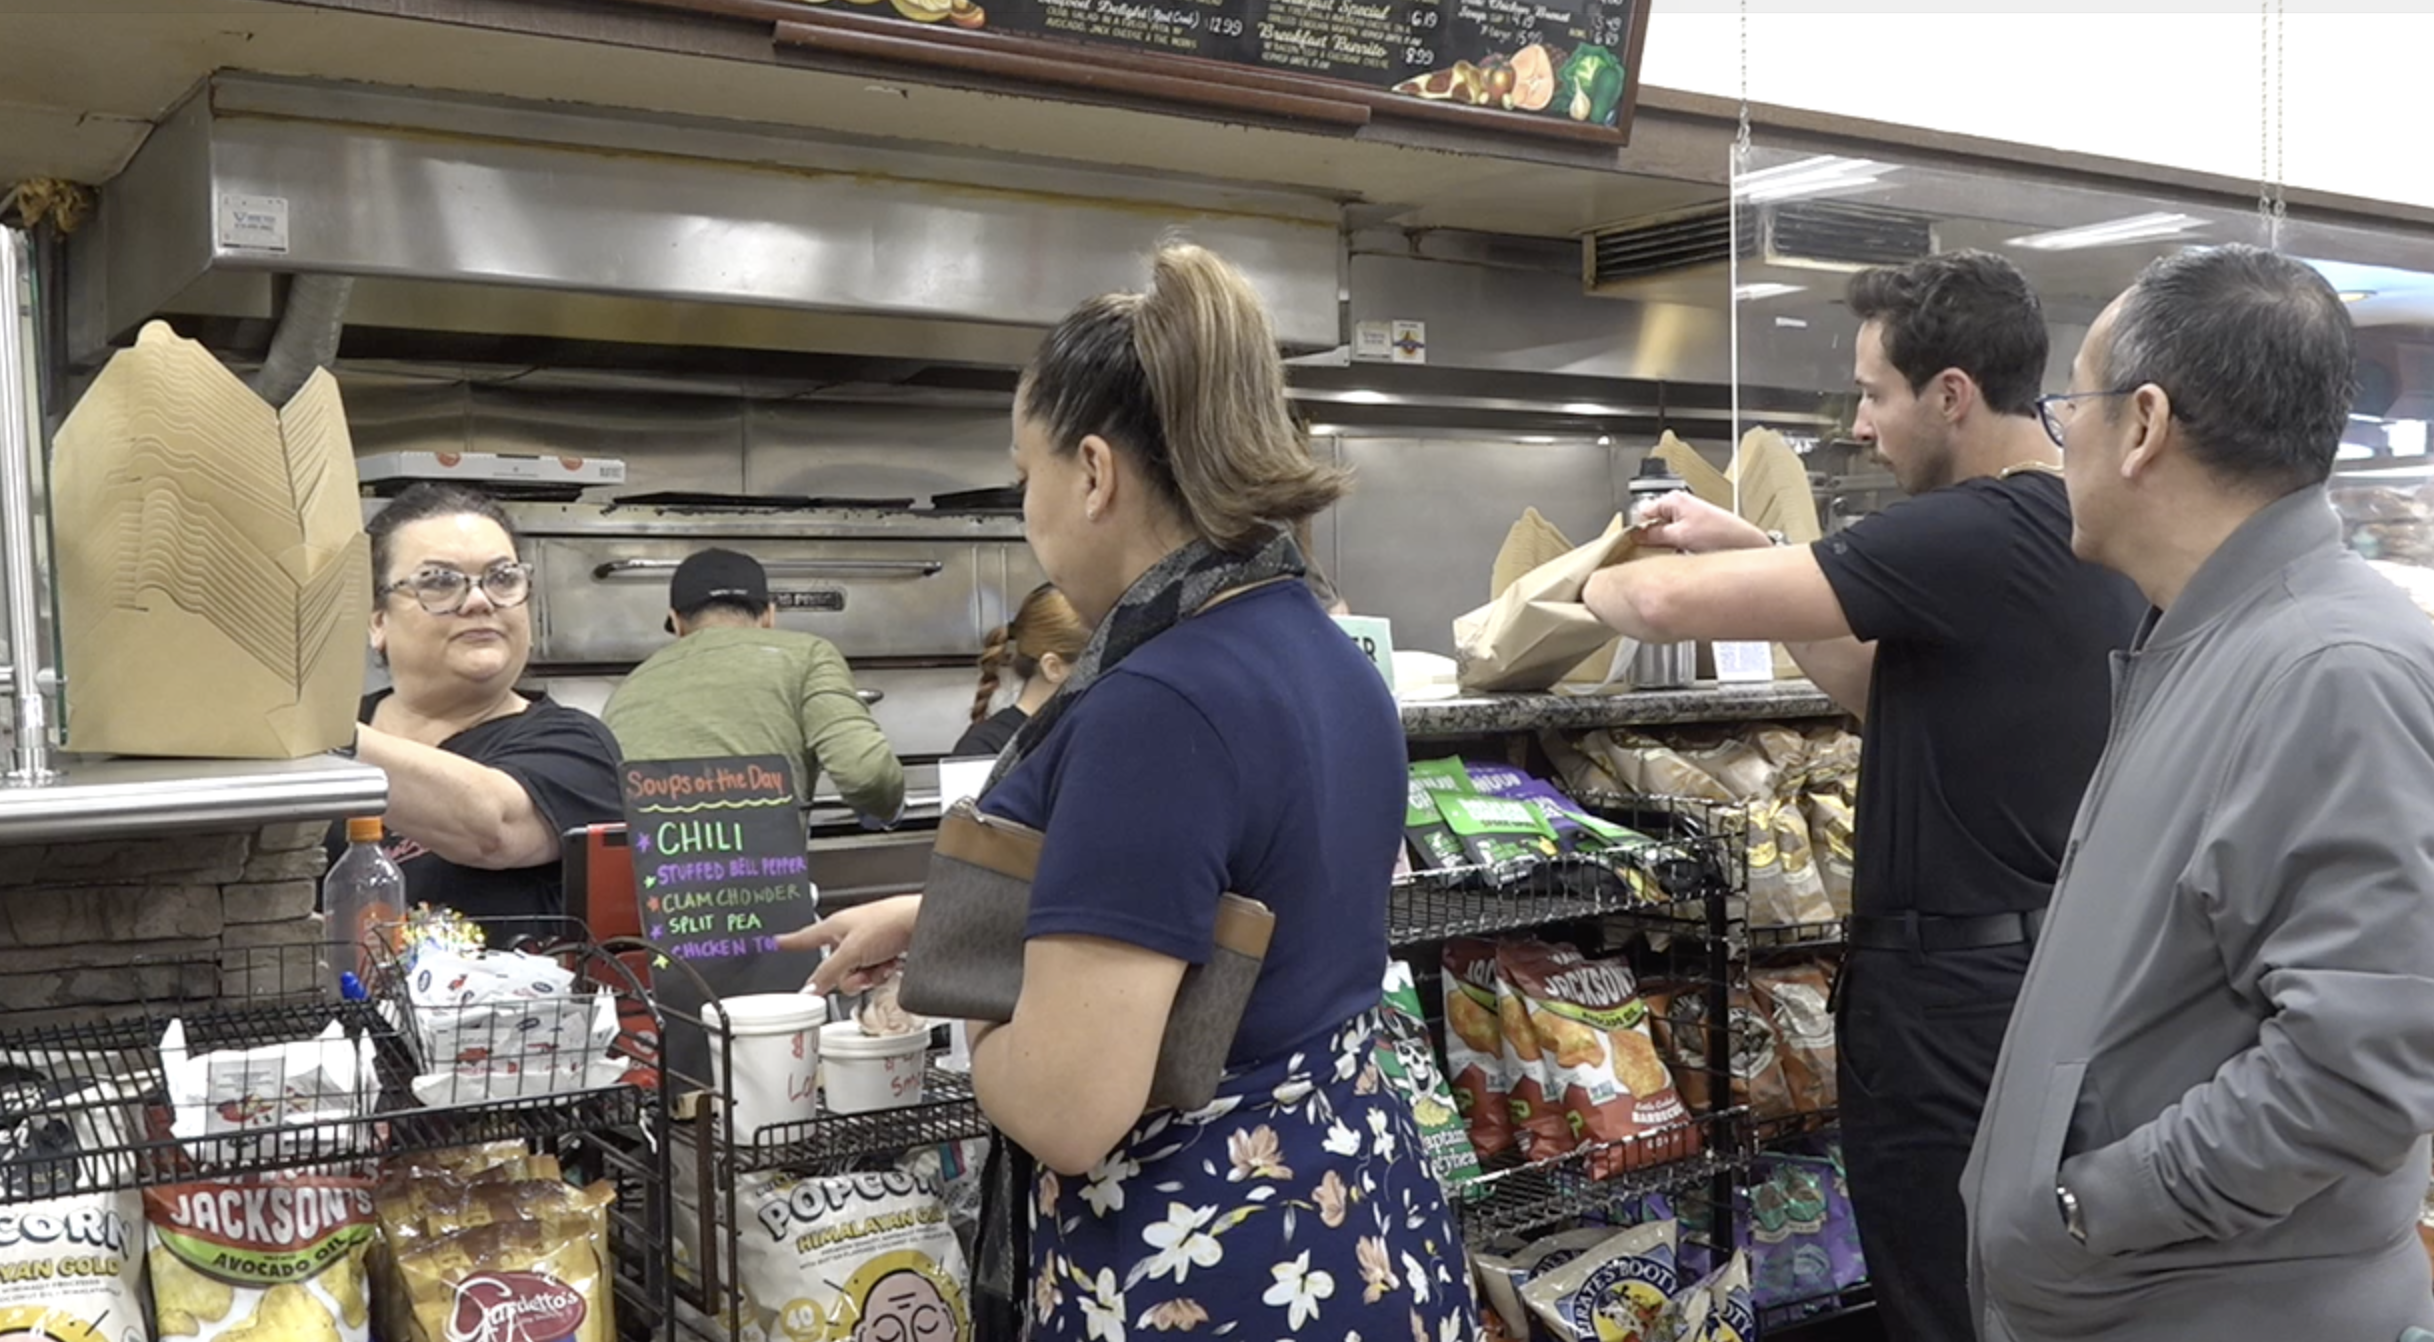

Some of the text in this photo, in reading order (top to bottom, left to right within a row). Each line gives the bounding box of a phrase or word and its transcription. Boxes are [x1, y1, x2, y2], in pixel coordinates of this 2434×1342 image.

[1257, 21, 1388, 58] Breakfast Burrito
[627, 769, 691, 800] Soups
[716, 768, 747, 790] the
[748, 764, 783, 795] Day
[657, 820, 743, 855] CHILI
[657, 855, 808, 885] STUFFED BELL PEPPER
[662, 883, 801, 914] CLAM CHOWDER
[669, 913, 763, 935] SPLIT PEA
[671, 938, 747, 960] CHICKEN
[169, 1184, 375, 1246] JACKSON'S
[796, 1208, 915, 1254] HIMALAYAN
[57, 1255, 120, 1278] GOLD
[212, 1236, 347, 1278] AVOCADO OIL
[1618, 1257, 1679, 1296] BOOTY
[448, 1276, 580, 1342] Gardetto's
